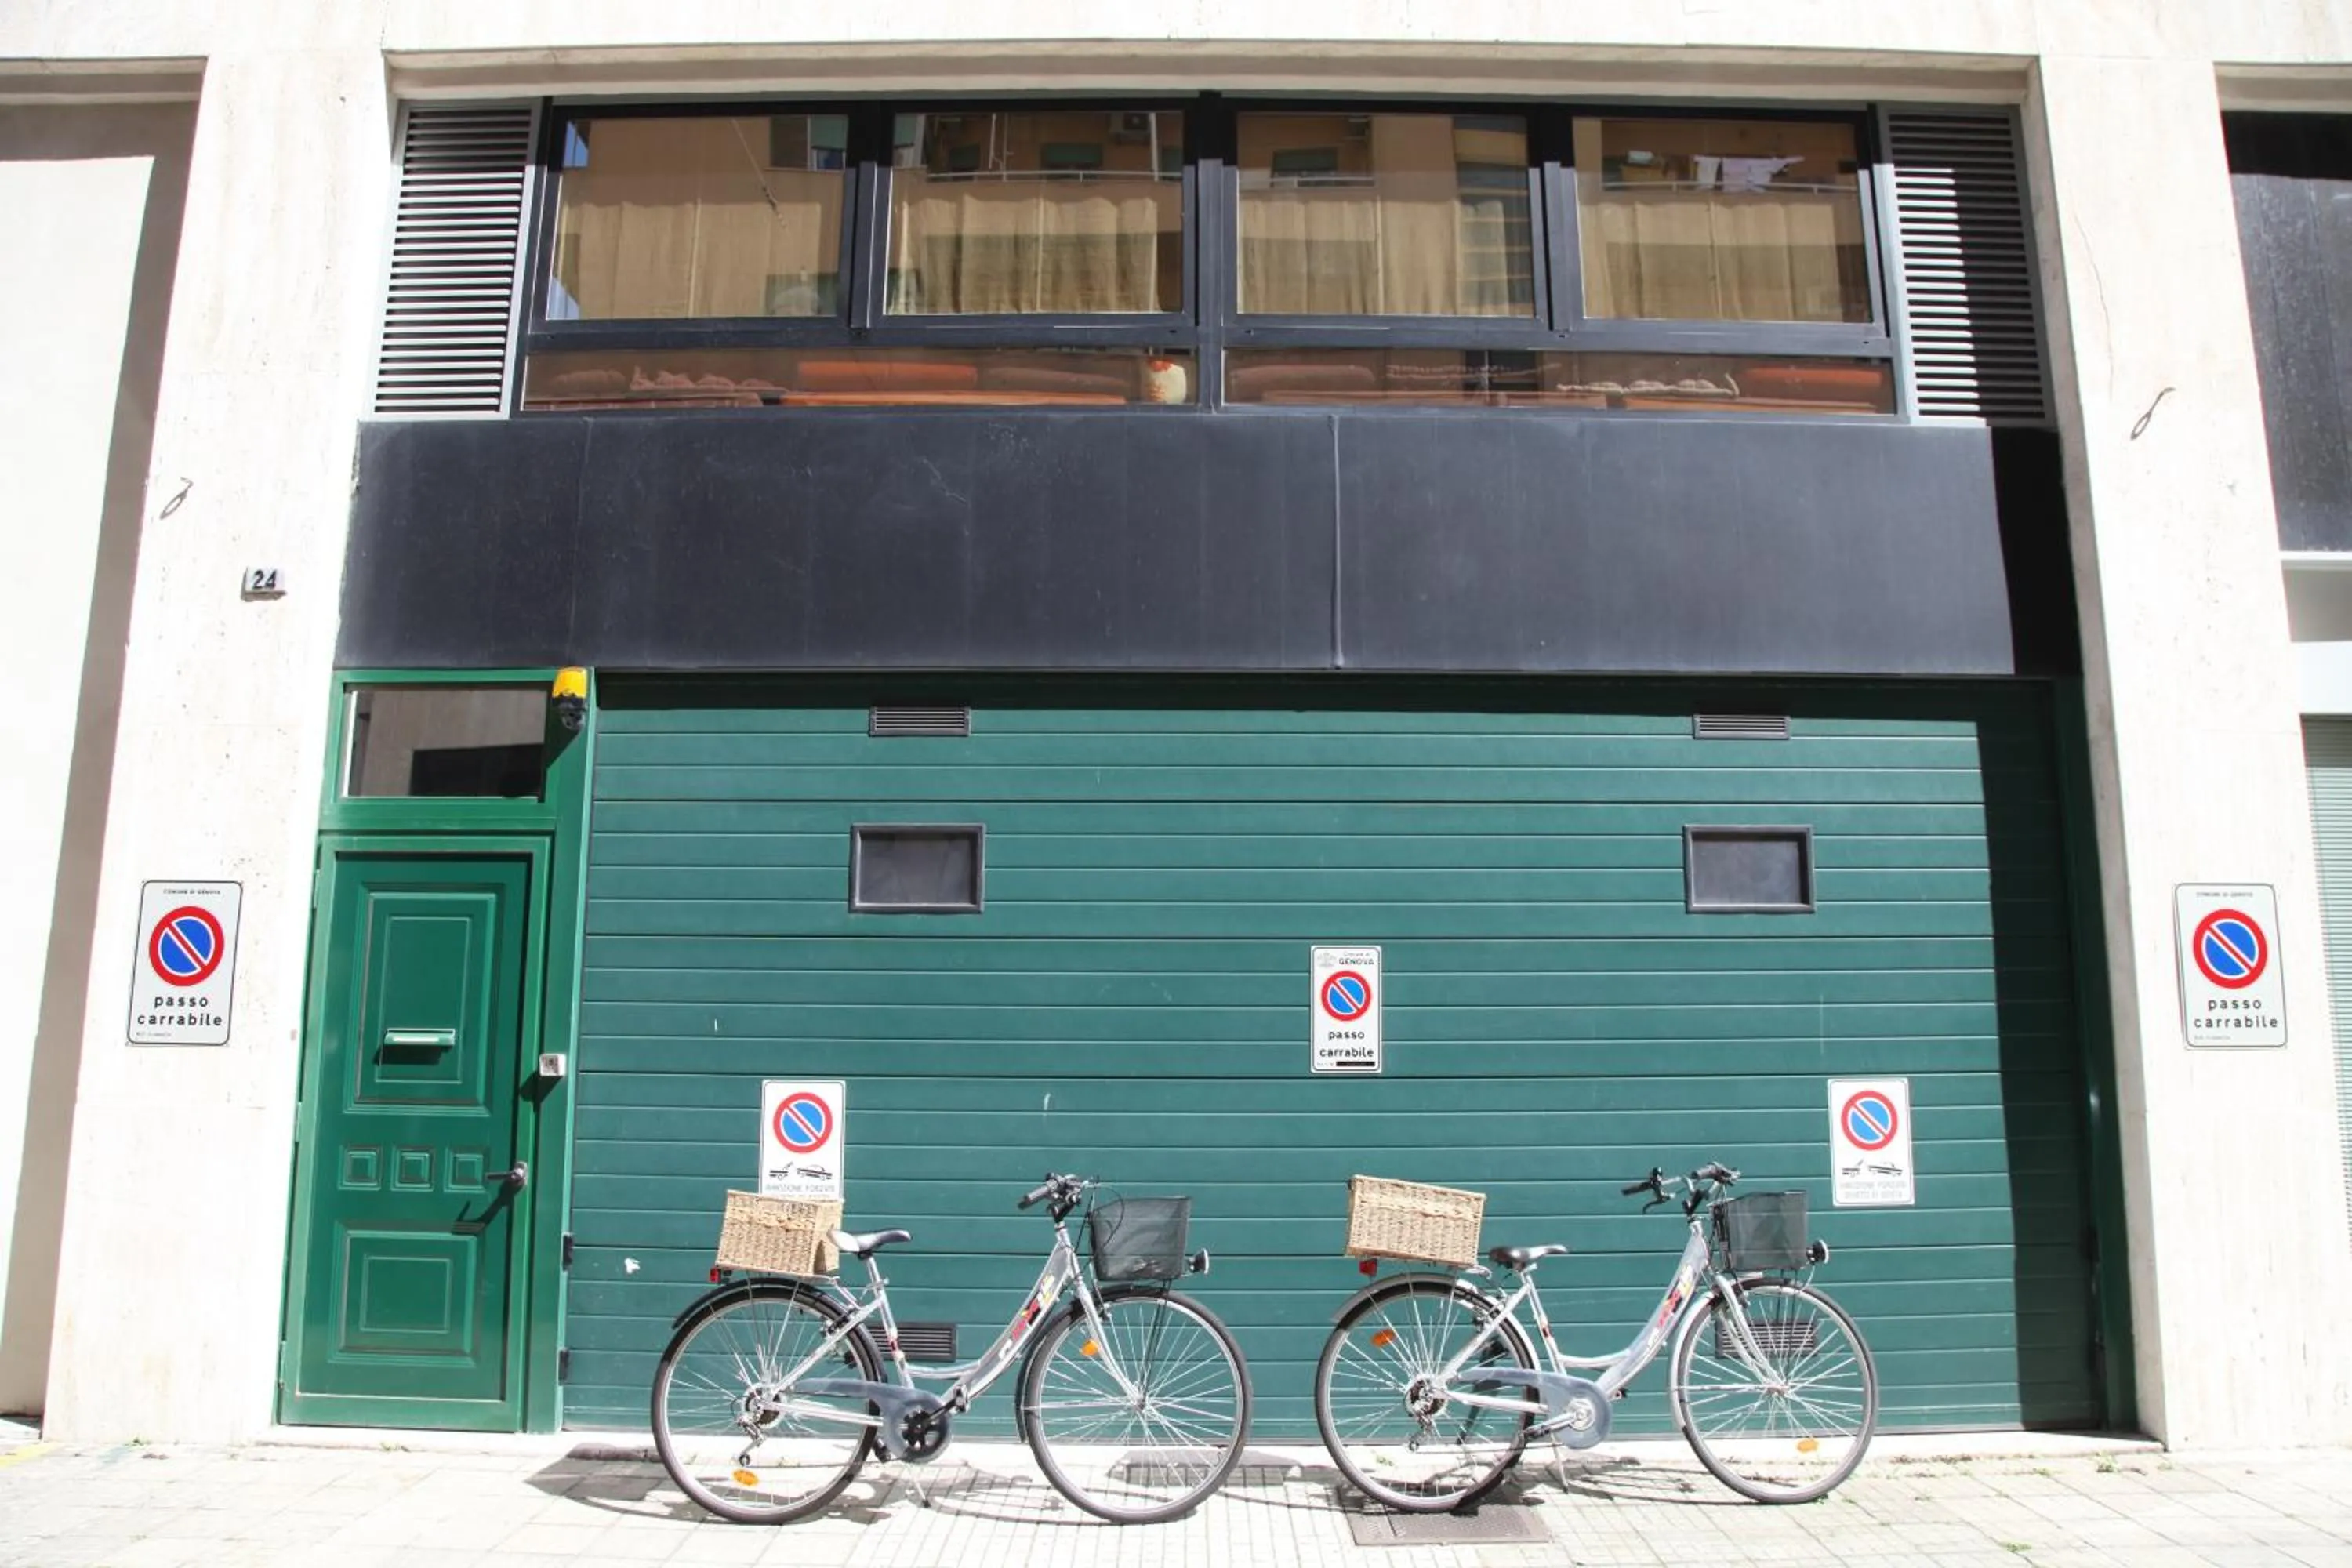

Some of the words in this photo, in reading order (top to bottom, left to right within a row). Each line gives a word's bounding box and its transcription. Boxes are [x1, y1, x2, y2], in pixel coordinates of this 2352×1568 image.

[252, 569, 277, 590] 24
[154, 996, 208, 1008] passo
[2208, 1000, 2262, 1011] passo
[137, 1013, 222, 1025] carrabile
[2194, 1016, 2278, 1028] carrabile
[1328, 1031, 1365, 1040] passo
[1319, 1047, 1374, 1057] carrabile
